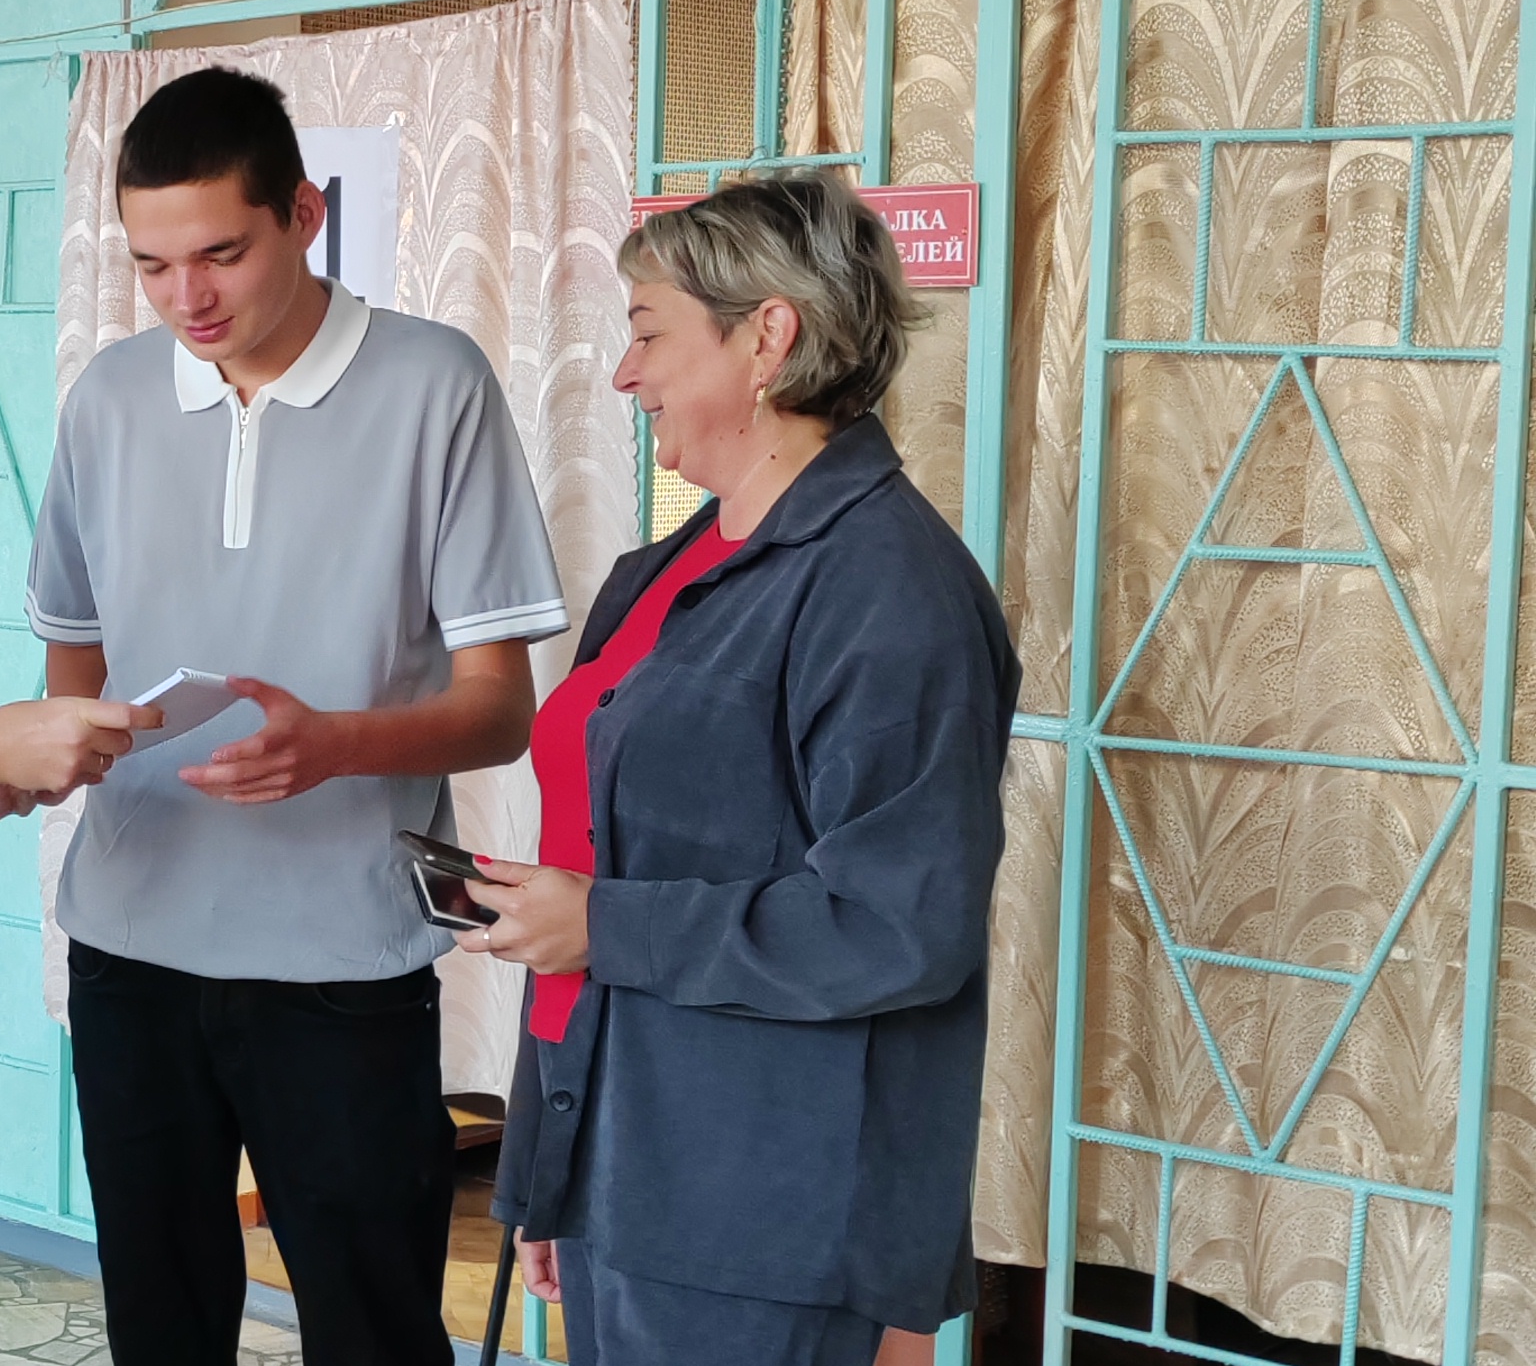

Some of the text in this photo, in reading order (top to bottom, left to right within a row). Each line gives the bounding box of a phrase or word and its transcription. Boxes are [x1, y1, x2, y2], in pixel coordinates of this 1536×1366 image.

[879, 209, 947, 231] АЛКА
[321, 176, 365, 303] 1
[895, 235, 964, 263] ЕЛЕЙ
